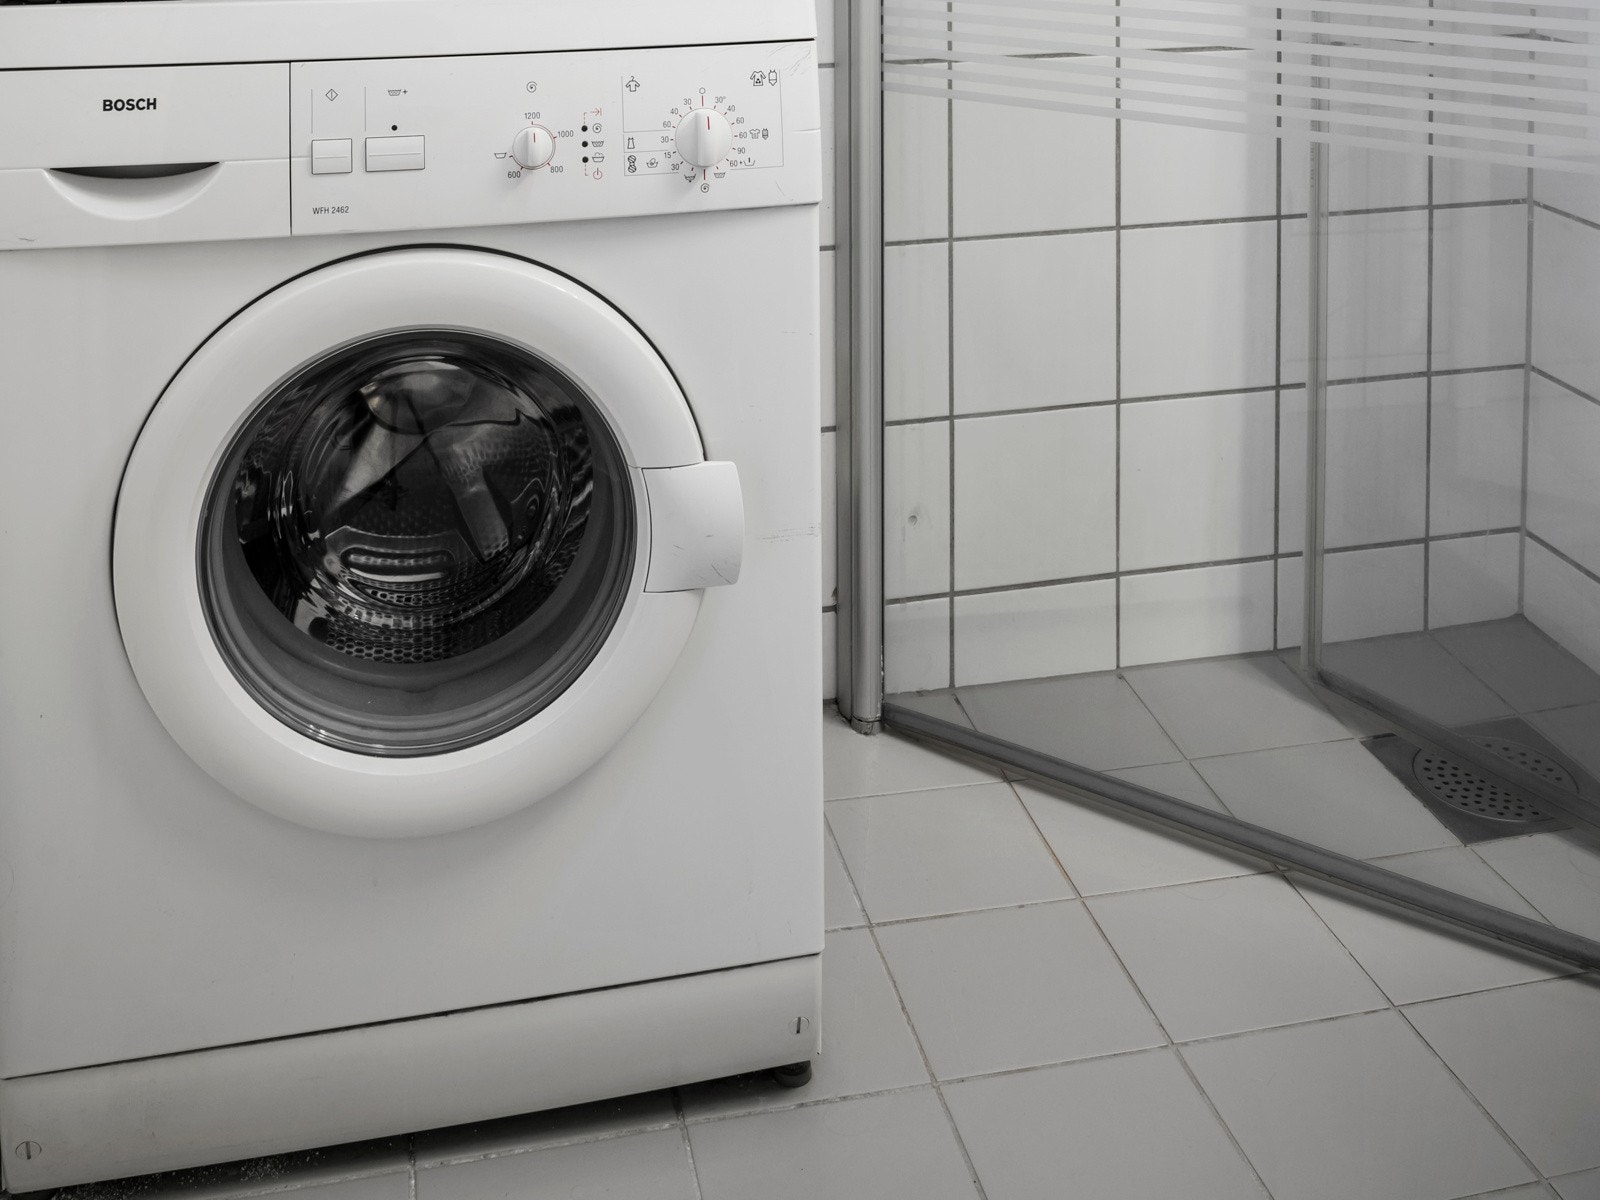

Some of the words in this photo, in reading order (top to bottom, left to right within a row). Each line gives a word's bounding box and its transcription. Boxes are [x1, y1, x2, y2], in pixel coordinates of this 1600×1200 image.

[102, 98, 157, 112] BOSCH
[524, 112, 541, 120] 1200
[558, 130, 574, 138] 1000
[660, 136, 670, 144] 30
[550, 166, 564, 174] 800
[312, 206, 330, 214] WFH
[332, 206, 350, 214] 2462
